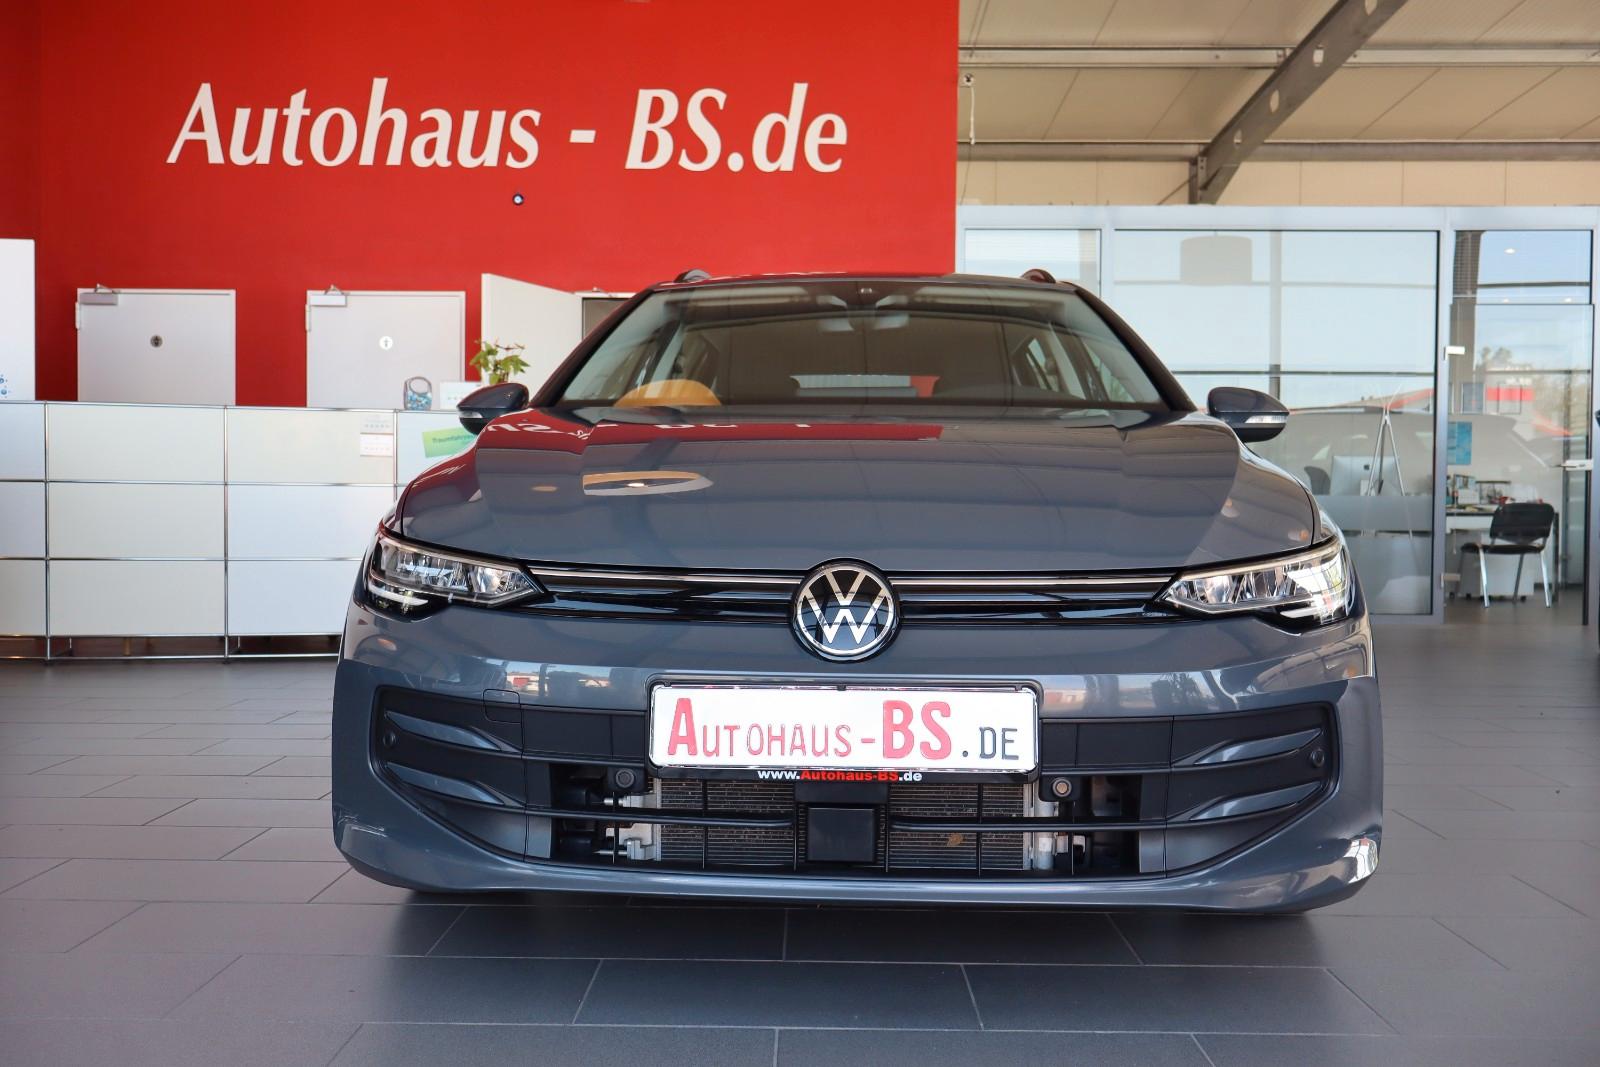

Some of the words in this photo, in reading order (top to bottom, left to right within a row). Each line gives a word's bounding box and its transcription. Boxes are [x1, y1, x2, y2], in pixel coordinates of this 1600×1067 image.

[166, 77, 542, 169] Autohaus
[569, 129, 596, 144] -
[624, 82, 848, 173] BS.de
[757, 768, 923, 782] www.Autohaus-BS.de
